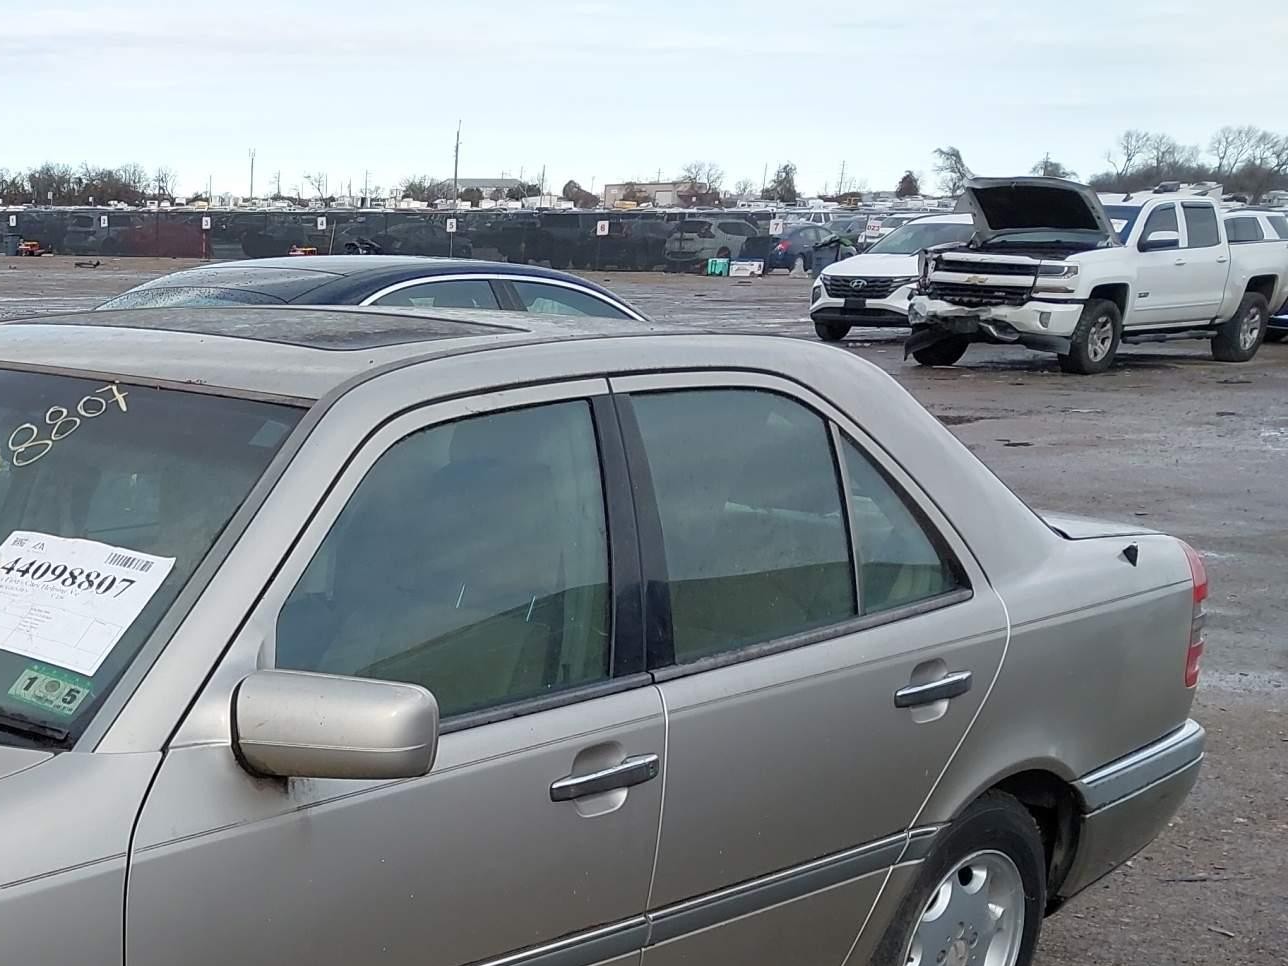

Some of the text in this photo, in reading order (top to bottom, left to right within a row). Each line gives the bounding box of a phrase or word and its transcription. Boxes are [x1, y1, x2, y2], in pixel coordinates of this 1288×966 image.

[0, 557, 136, 599] 44098807
[23, 676, 38, 692] 1
[61, 687, 81, 705] 5
